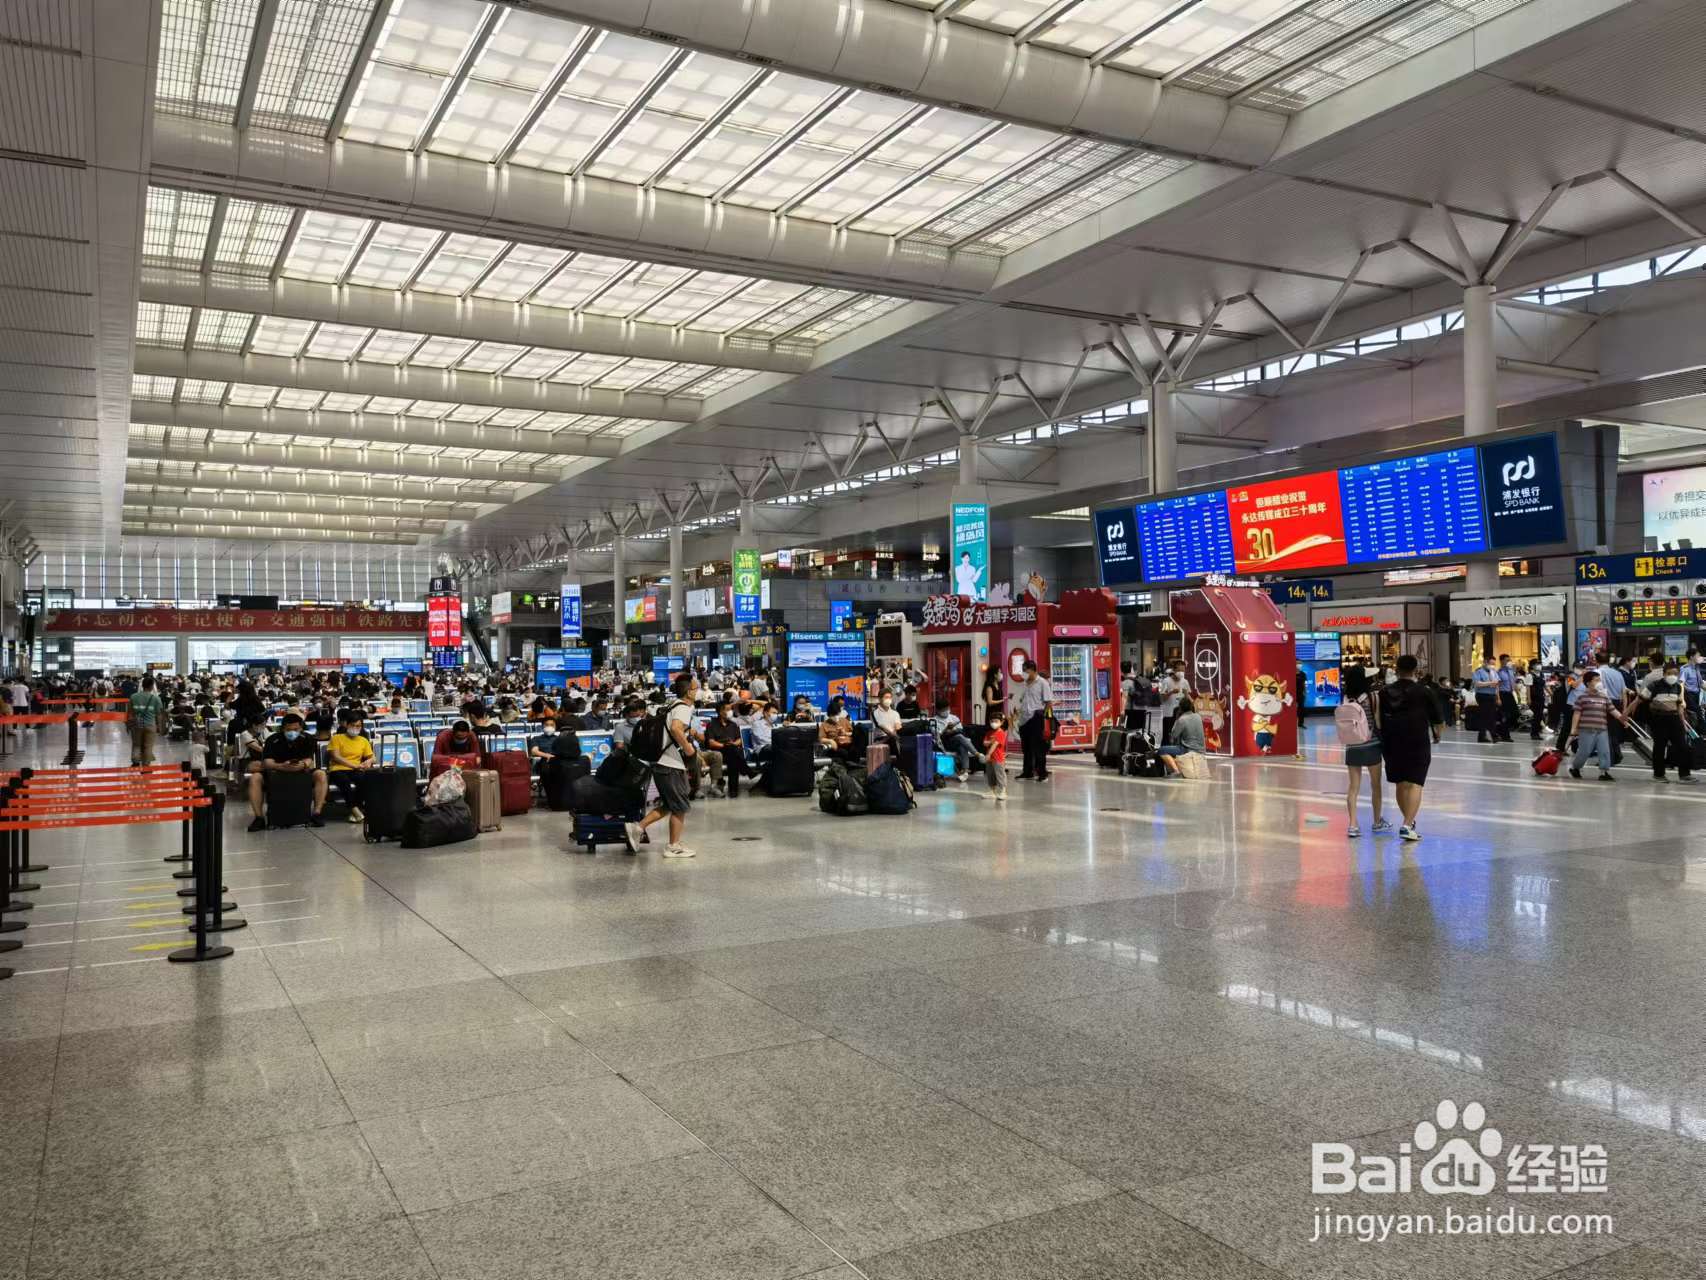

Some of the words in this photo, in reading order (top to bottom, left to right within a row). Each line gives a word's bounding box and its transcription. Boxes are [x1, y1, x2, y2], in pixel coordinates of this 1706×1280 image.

[1503, 486, 1540, 501] 浦发银行
[1247, 527, 1277, 561] 30
[1579, 562, 1607, 579] 13A
[1288, 584, 1306, 598] 14A
[1312, 584, 1329, 598] 14A
[72, 612, 158, 627] 不忘初心
[172, 612, 257, 628] 牢记使命
[271, 613, 346, 628] 交通强国
[790, 632, 824, 641] Hisense
